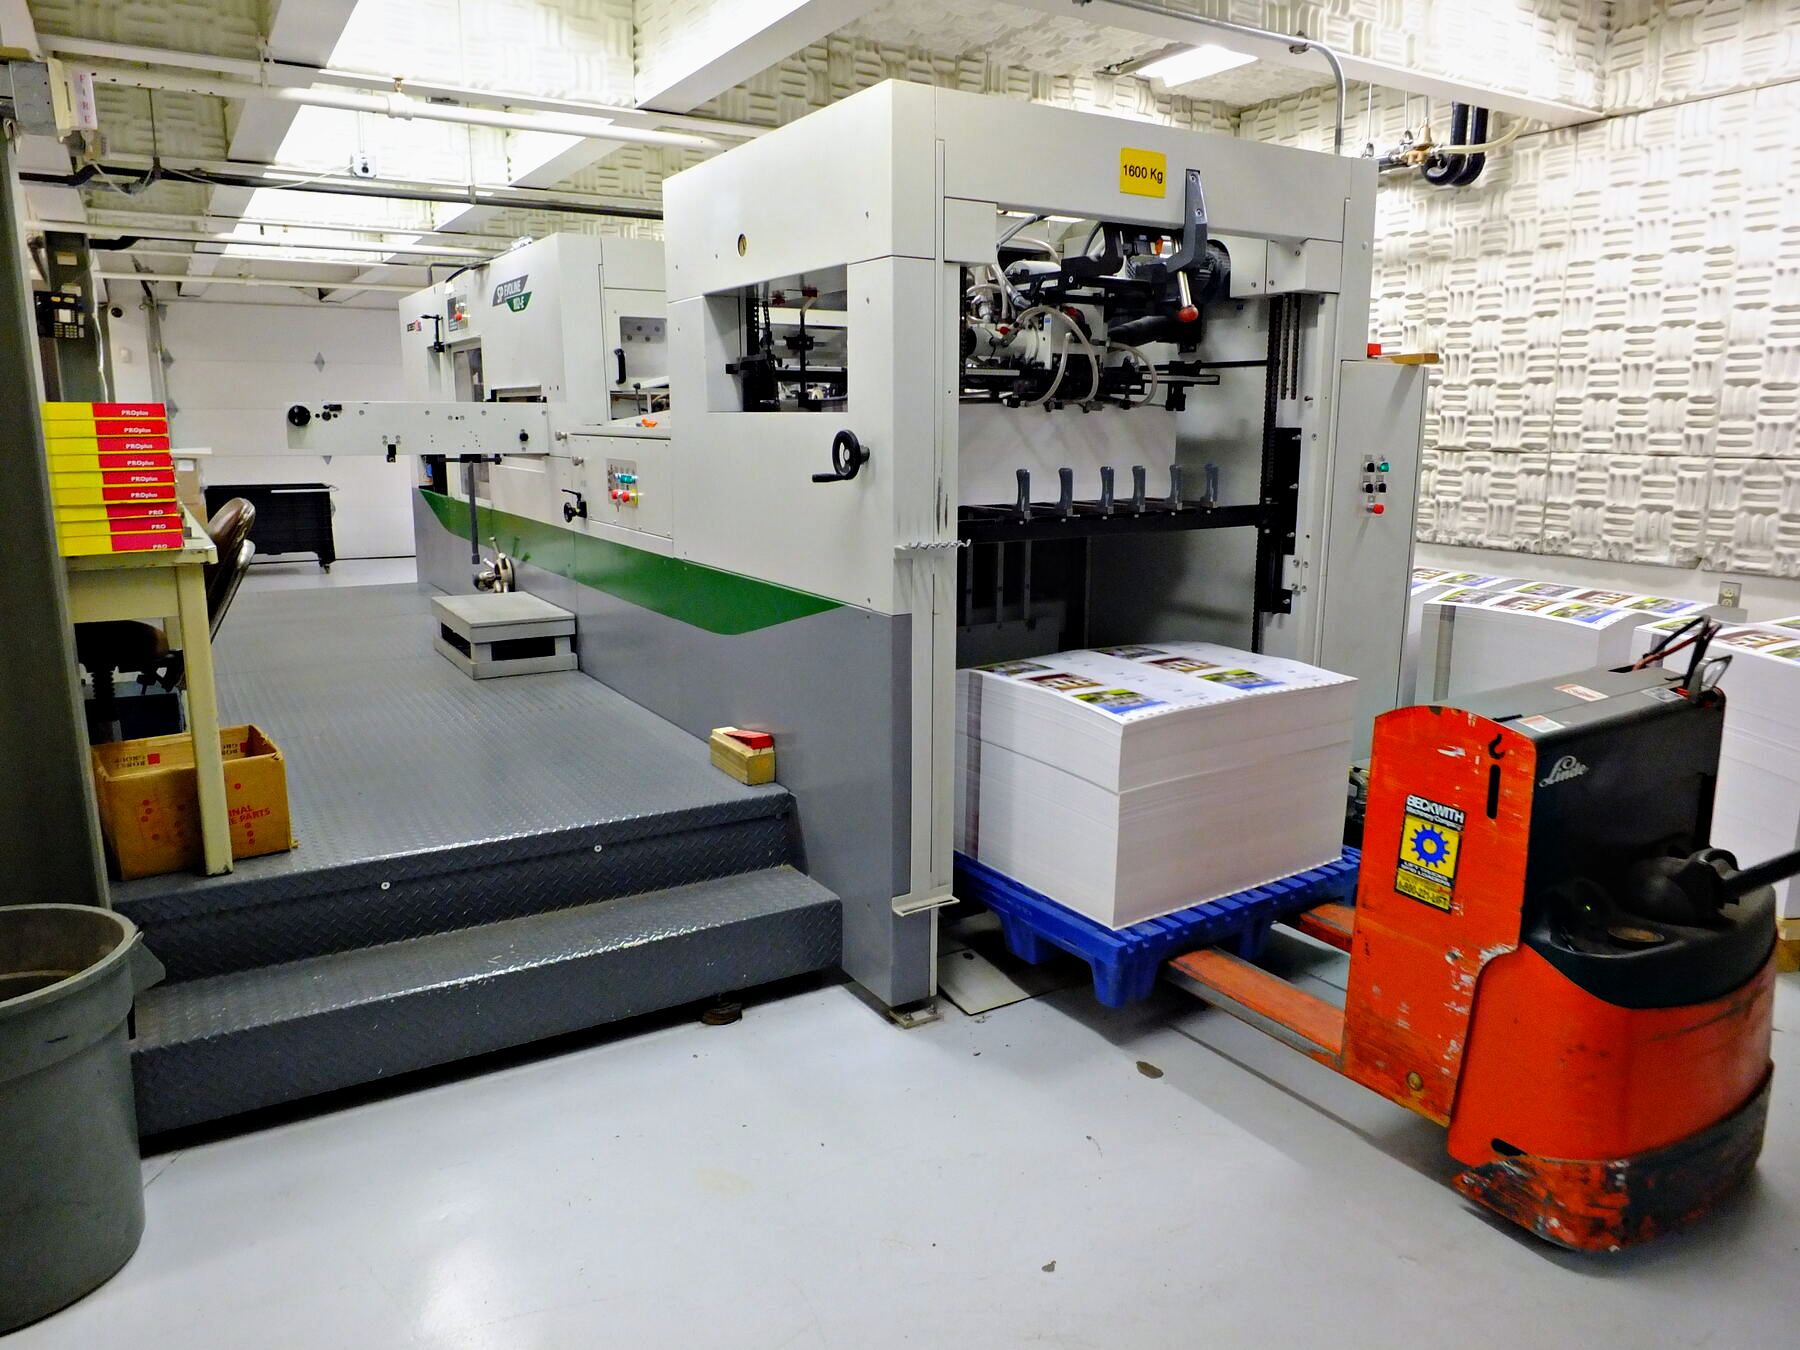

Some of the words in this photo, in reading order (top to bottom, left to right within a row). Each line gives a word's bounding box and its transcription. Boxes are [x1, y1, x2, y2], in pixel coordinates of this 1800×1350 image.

[1123, 164, 1148, 179] 1600
[1150, 167, 1163, 184] Kg
[1538, 755, 1590, 788] Linde
[240, 807, 272, 822] PARTS
[1406, 794, 1465, 824] BECKWITH
